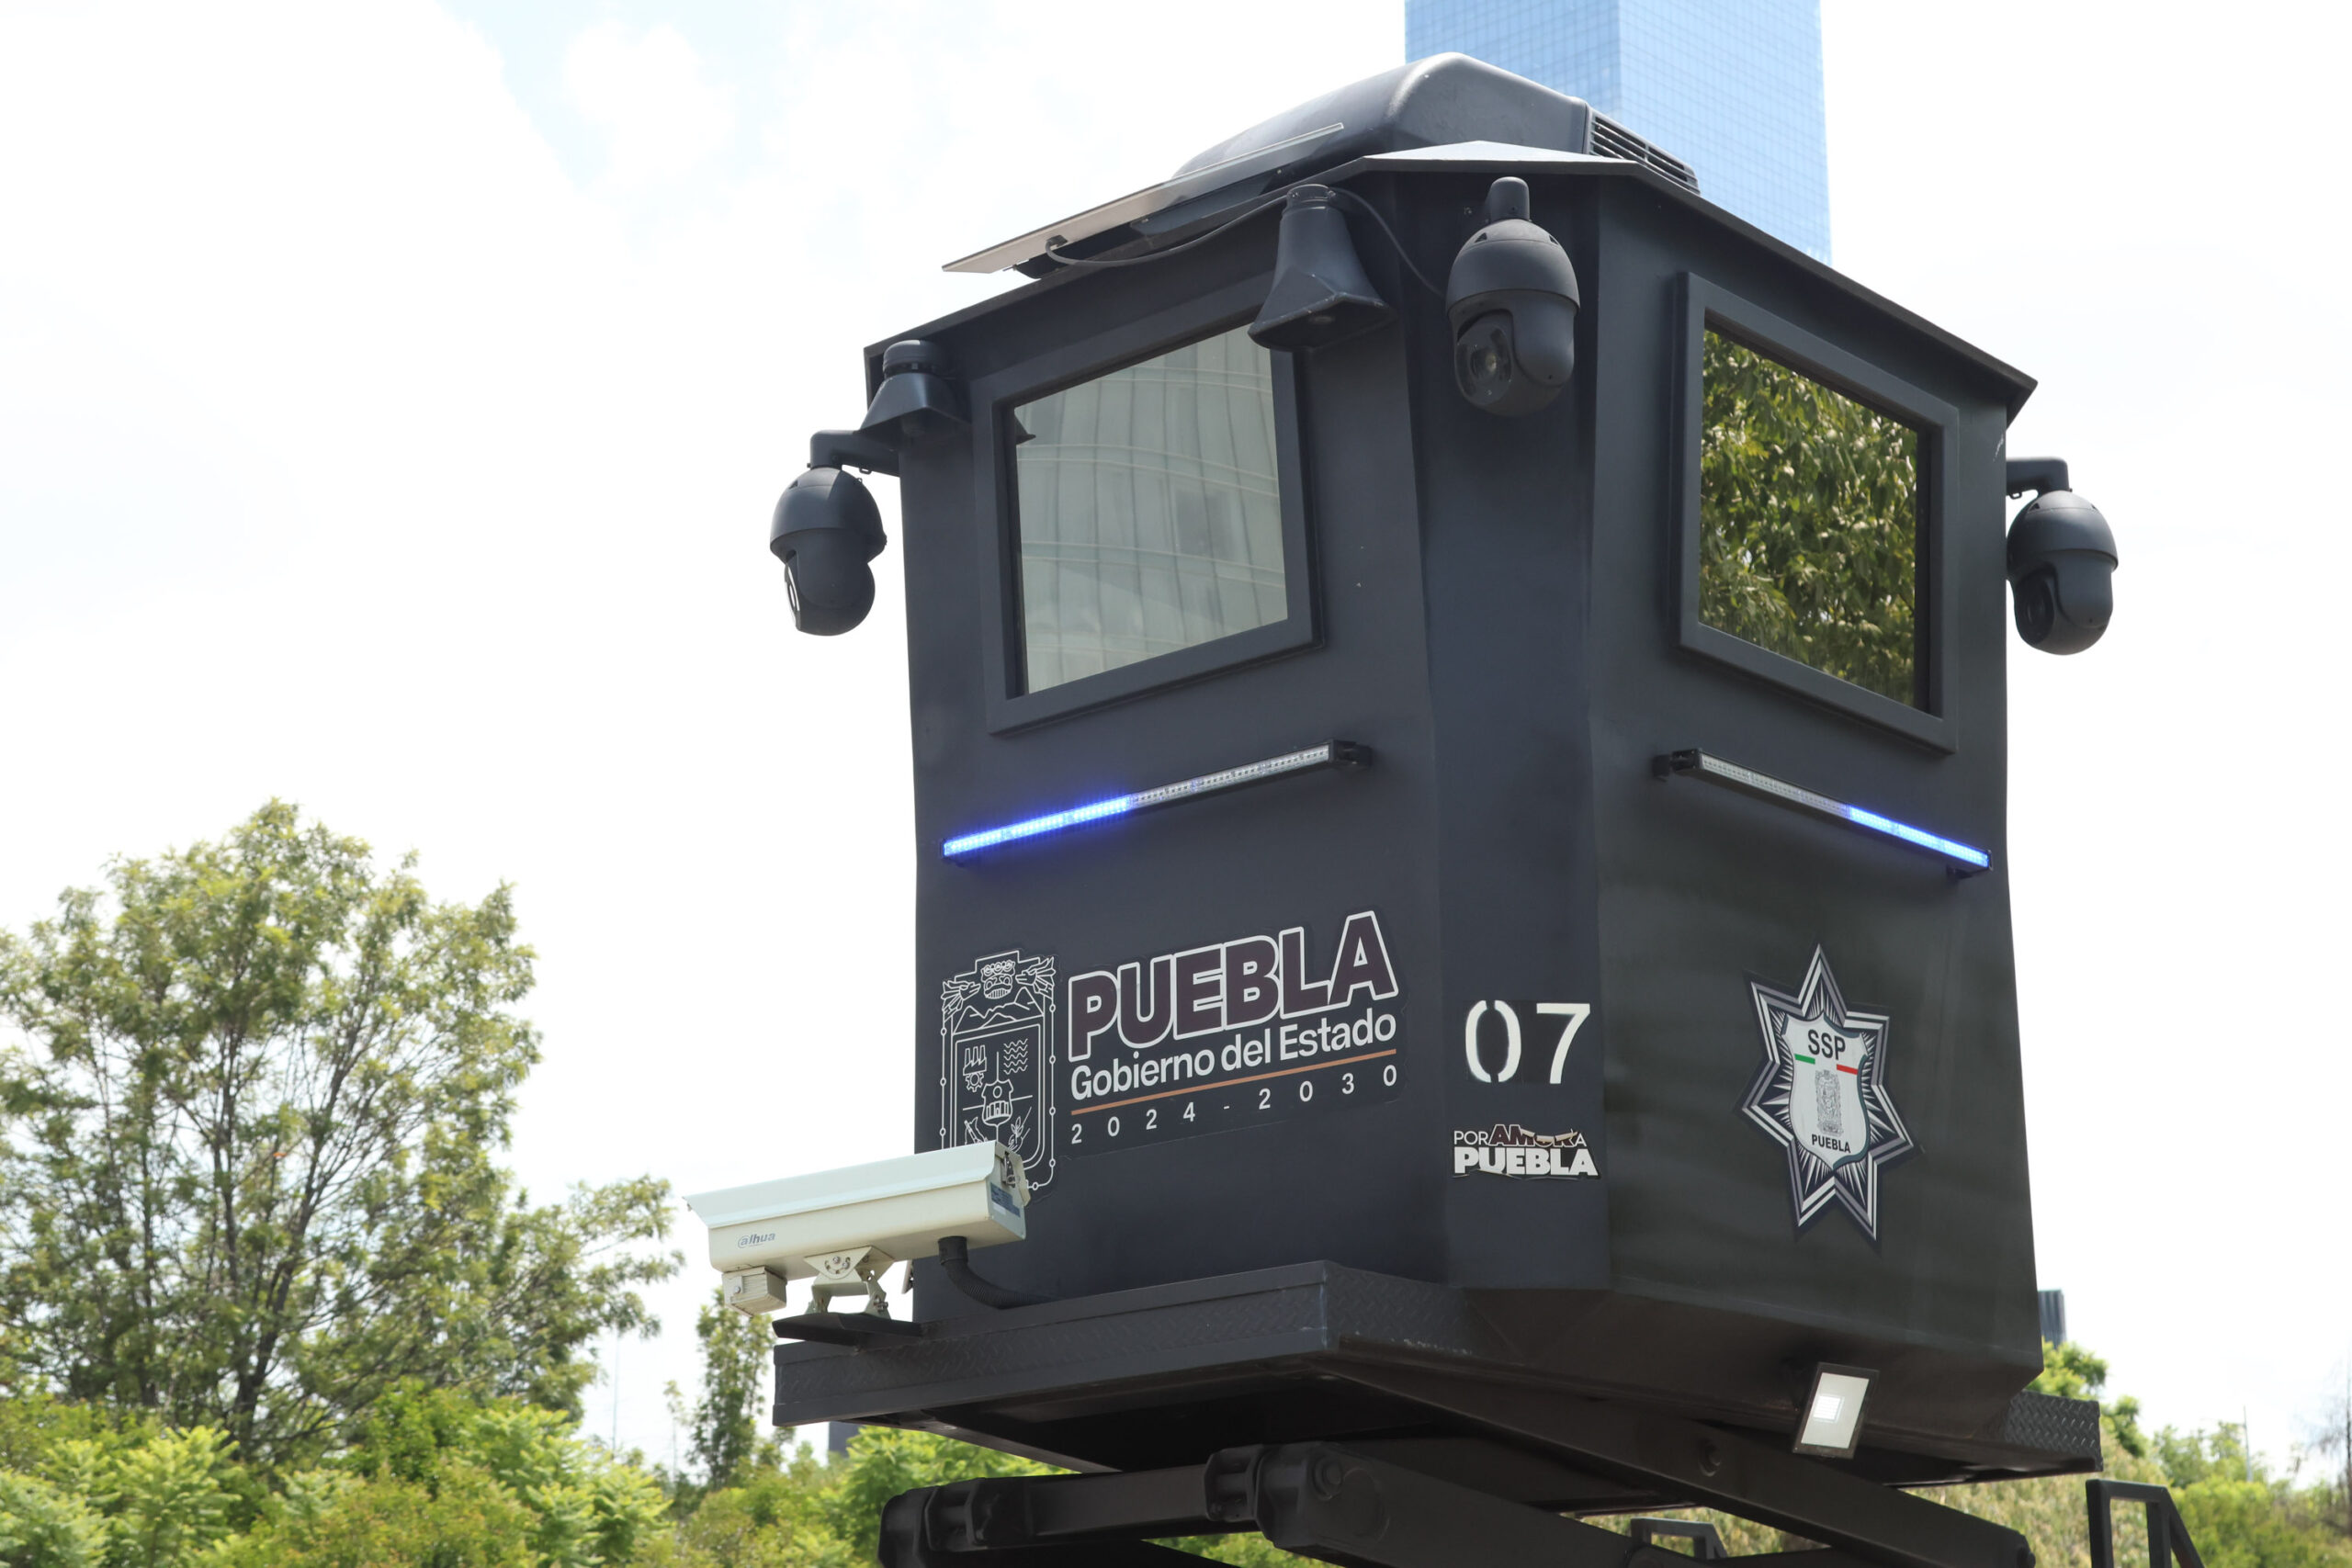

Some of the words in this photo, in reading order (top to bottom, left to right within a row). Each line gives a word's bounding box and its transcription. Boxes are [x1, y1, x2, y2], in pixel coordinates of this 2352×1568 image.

[1068, 910, 1398, 1062] PUEBLA
[1071, 1052, 1214, 1100] Gobierno
[1221, 1028, 1271, 1071] del
[1280, 1008, 1396, 1060] Estado
[1465, 999, 1590, 1084] 07
[1808, 1029, 1846, 1060] SSP
[1453, 1131, 1489, 1145] POR
[1575, 1133, 1588, 1146] A
[1811, 1134, 1851, 1154] PUEBLA
[1453, 1146, 1599, 1176] PUEBLA
